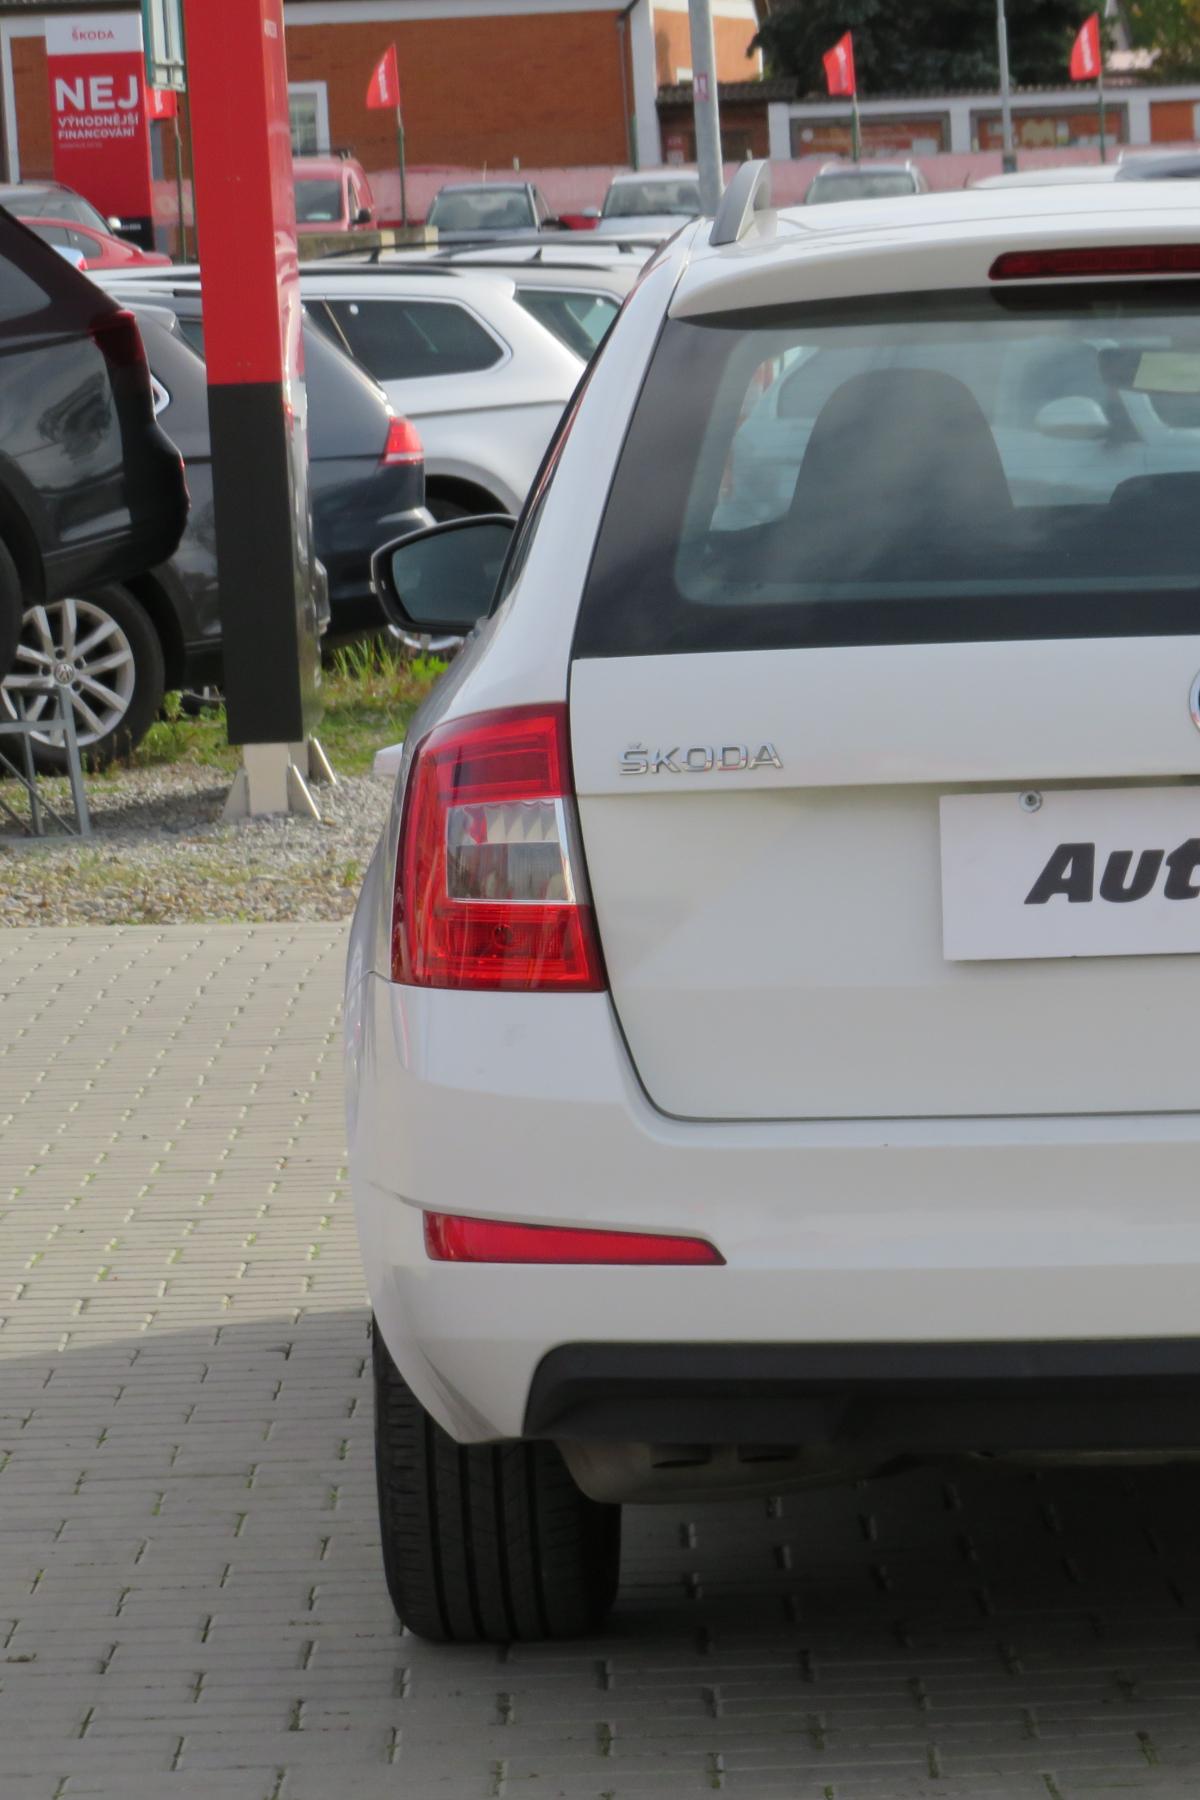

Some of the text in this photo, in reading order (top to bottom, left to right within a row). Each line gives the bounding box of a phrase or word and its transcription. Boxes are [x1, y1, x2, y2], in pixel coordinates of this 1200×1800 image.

[72, 25, 115, 41] ŠKODA
[55, 75, 139, 112] NEJ
[618, 741, 784, 776] ŠKODA
